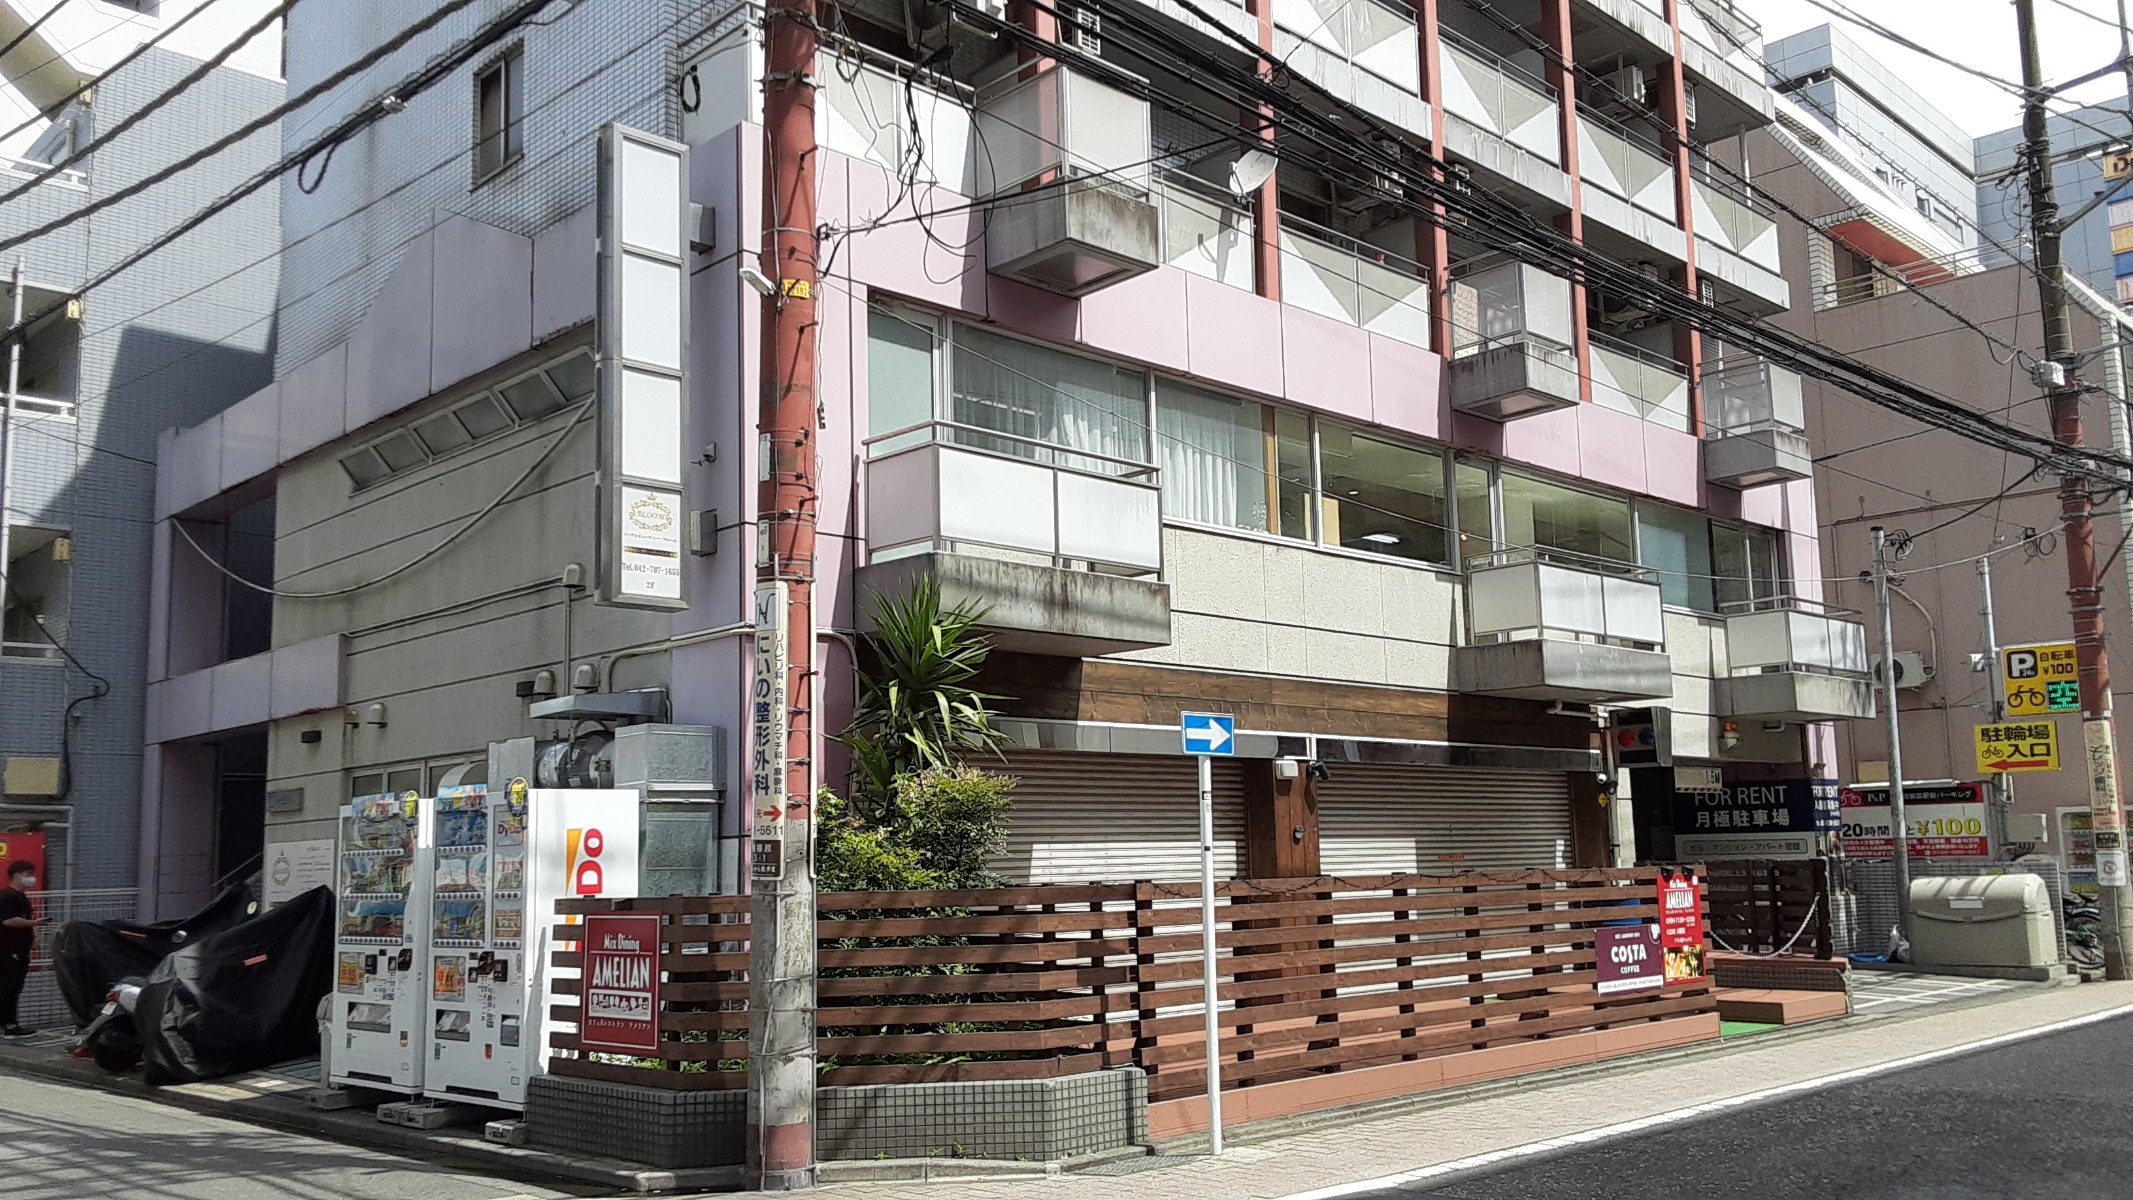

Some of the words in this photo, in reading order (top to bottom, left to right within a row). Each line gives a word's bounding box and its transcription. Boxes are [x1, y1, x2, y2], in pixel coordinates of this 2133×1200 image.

[637, 510, 666, 520] BLOOM
[646, 581, 655, 589] 2F
[2010, 653, 2035, 677] P
[2039, 650, 2075, 662] 自転車
[2042, 663, 2074, 675] ¥100
[755, 634, 771, 796] にいの整形外科
[1981, 725, 2050, 742] 駐輪場
[2006, 743, 2051, 758] 入口
[1695, 787, 1733, 807] FOR
[1737, 785, 1788, 805] RENT
[1696, 808, 1790, 828] 月極駐車場
[1916, 818, 1981, 836] ¥100
[1666, 891, 1694, 909] AMELIAN
[604, 933, 617, 949] Mix
[617, 933, 640, 954] Dining
[1610, 943, 1647, 963] COSTA
[592, 956, 650, 989] AMELIAN
[1620, 965, 1640, 975] COFFEE
